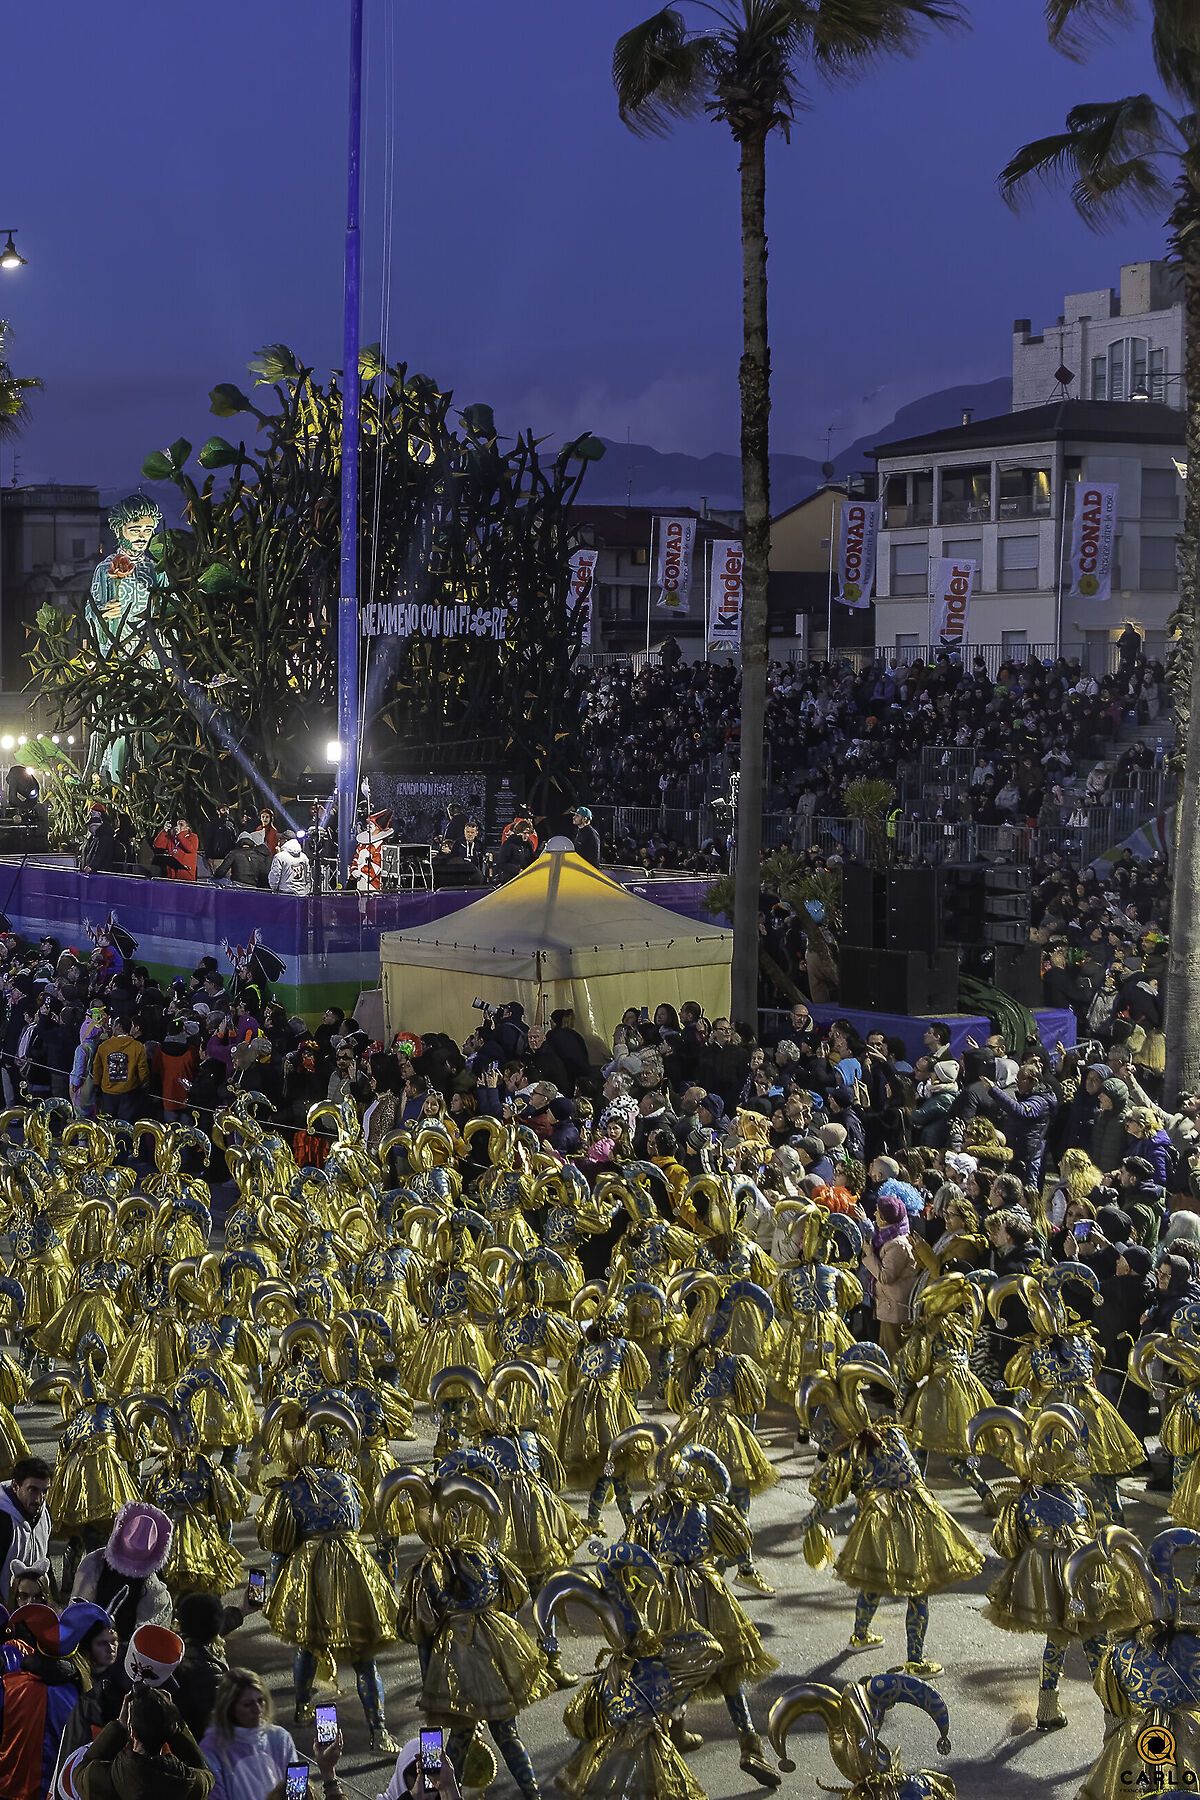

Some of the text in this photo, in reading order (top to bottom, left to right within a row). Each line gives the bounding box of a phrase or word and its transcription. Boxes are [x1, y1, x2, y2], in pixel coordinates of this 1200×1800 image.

[664, 522, 683, 591] CONAD
[845, 506, 865, 582] CONAD
[1078, 490, 1102, 573] CONAD
[362, 602, 419, 638] NEMMENO
[420, 603, 441, 637] CON
[443, 605, 457, 638] UN
